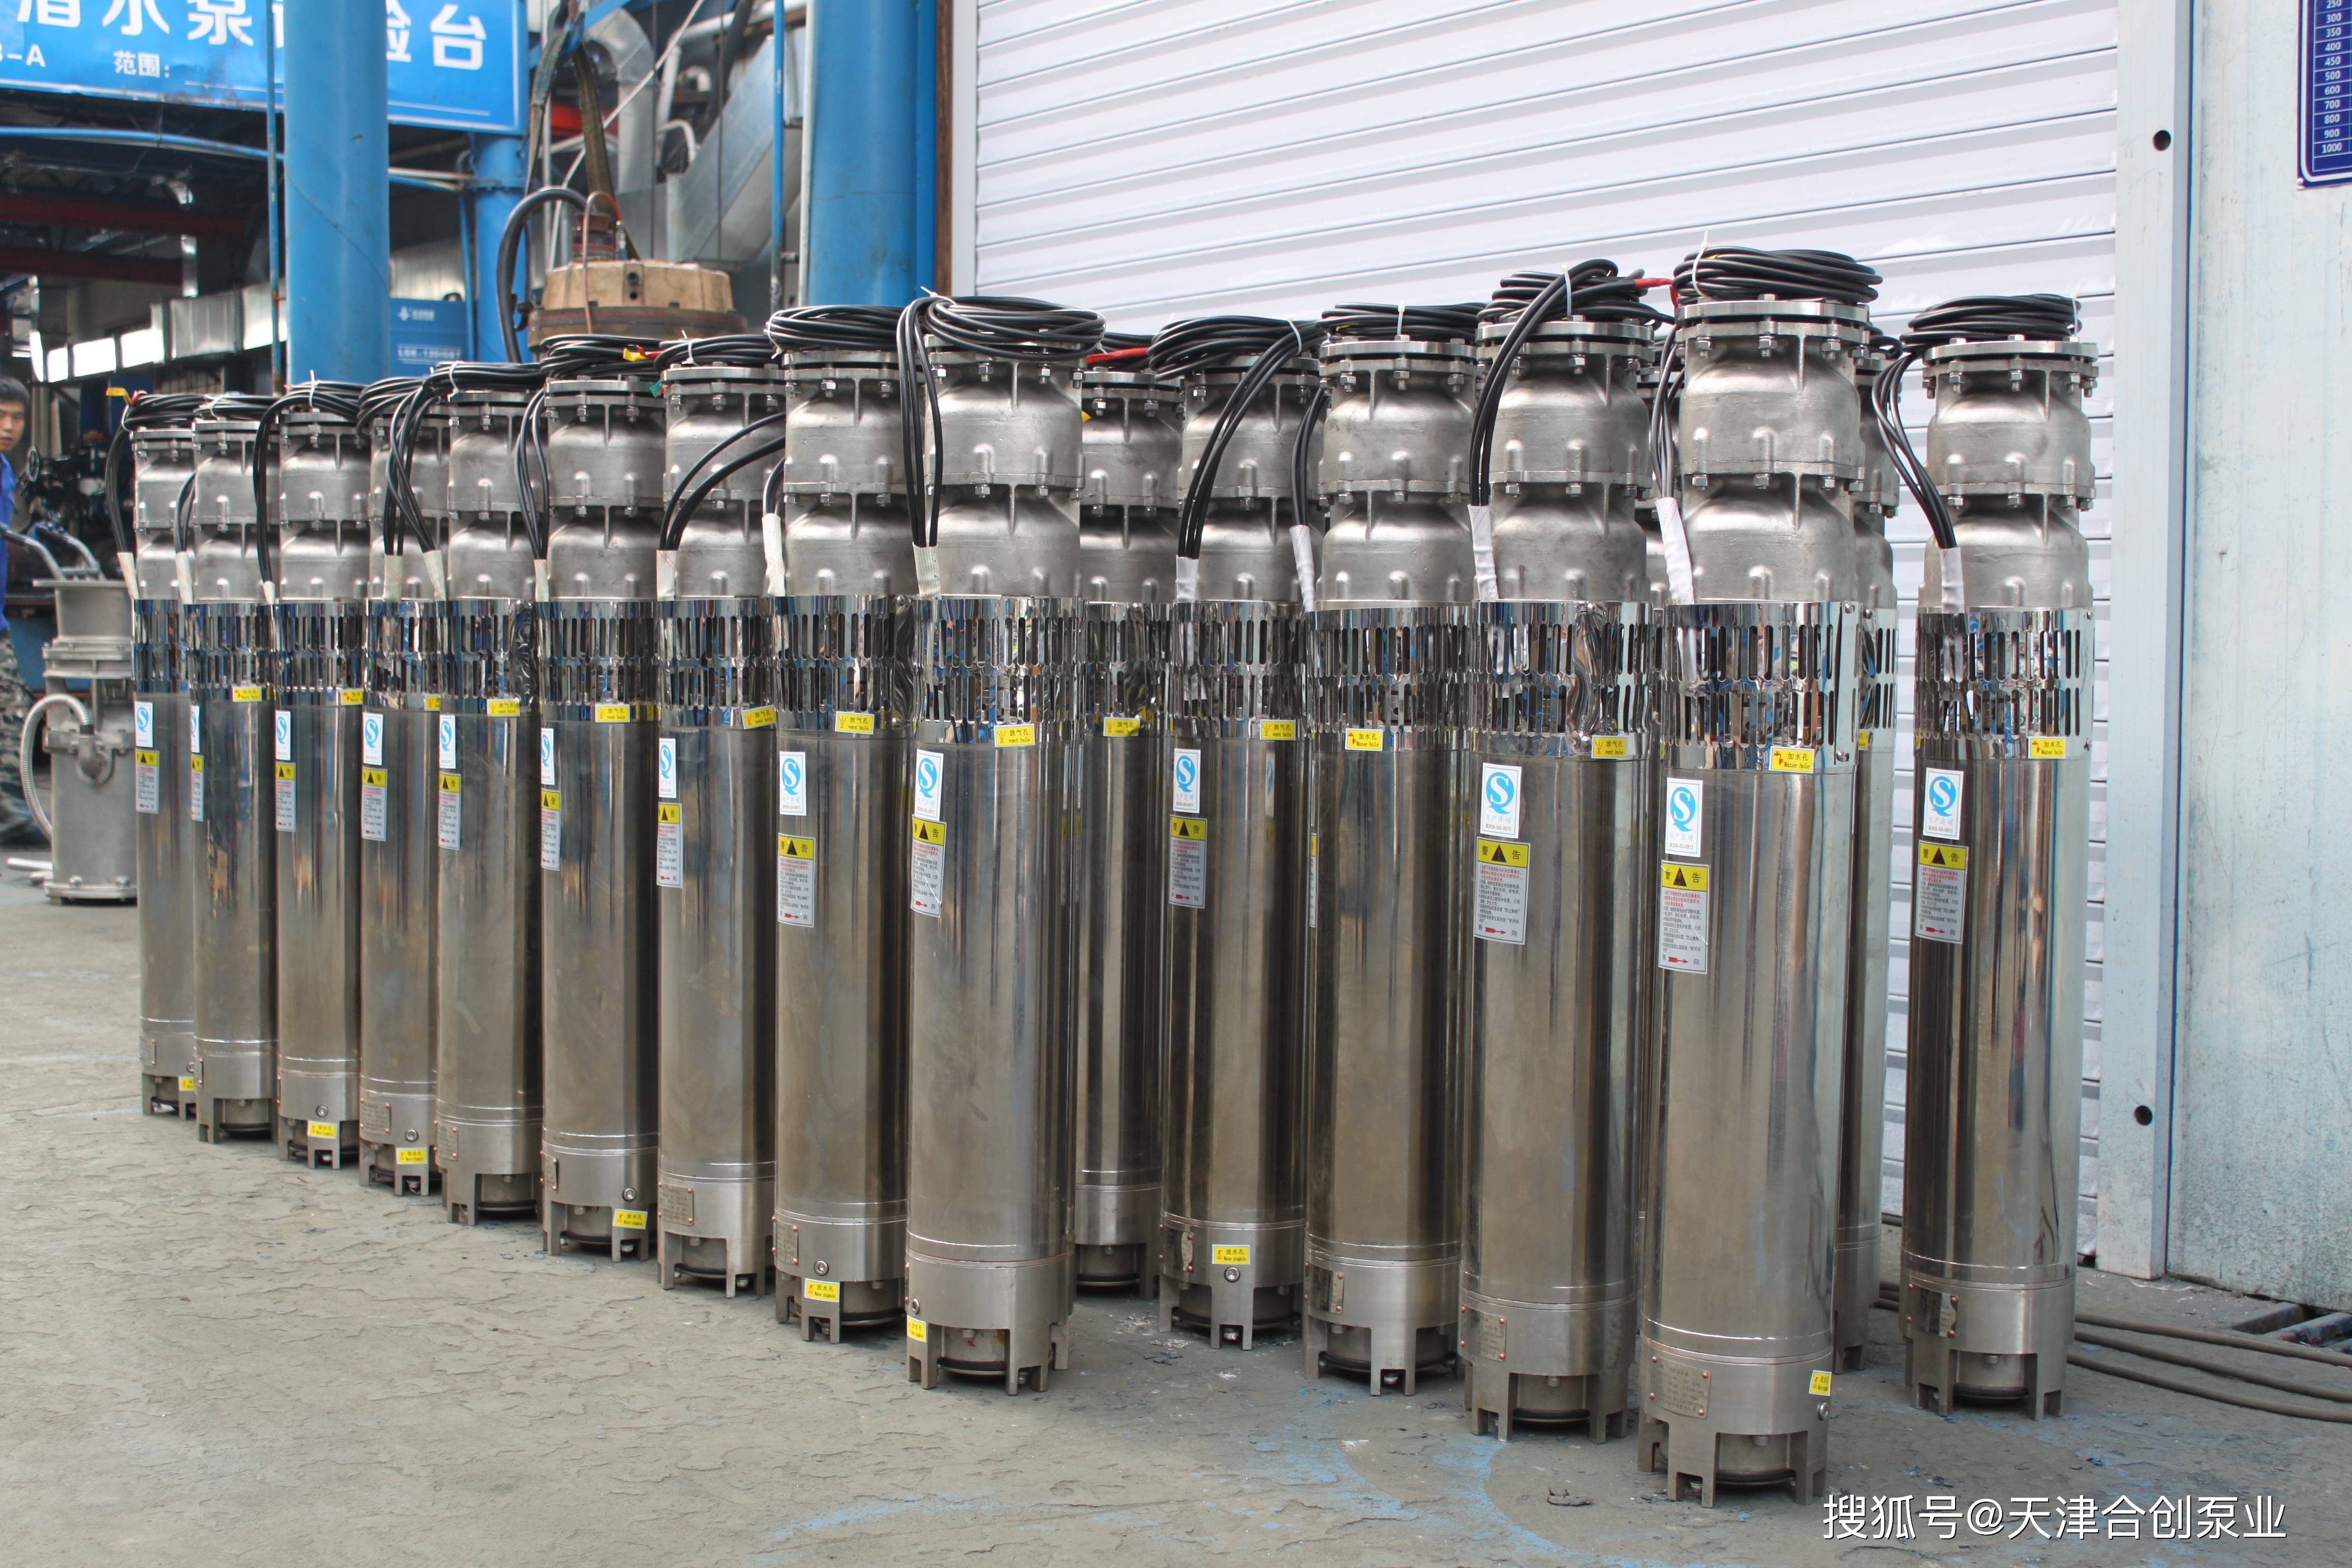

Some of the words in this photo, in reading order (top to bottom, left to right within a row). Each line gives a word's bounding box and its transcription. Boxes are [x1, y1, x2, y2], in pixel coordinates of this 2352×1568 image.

[2326, 12, 2342, 23] 300
[2326, 27, 2341, 38] 350
[2325, 41, 2341, 52] 400
[0, 43, 46, 67] -A
[2325, 55, 2341, 66] 450
[2325, 70, 2341, 81] 500
[2325, 85, 2340, 95] 600
[2325, 99, 2340, 110] 700
[2324, 114, 2340, 124] 800
[2324, 128, 2340, 138] 900
[2322, 143, 2342, 153] 1000
[1787, 752, 1808, 761] 加水孔
[1512, 849, 1521, 860] 告
[1950, 852, 1959, 863] 告
[1692, 873, 1701, 883] 告
